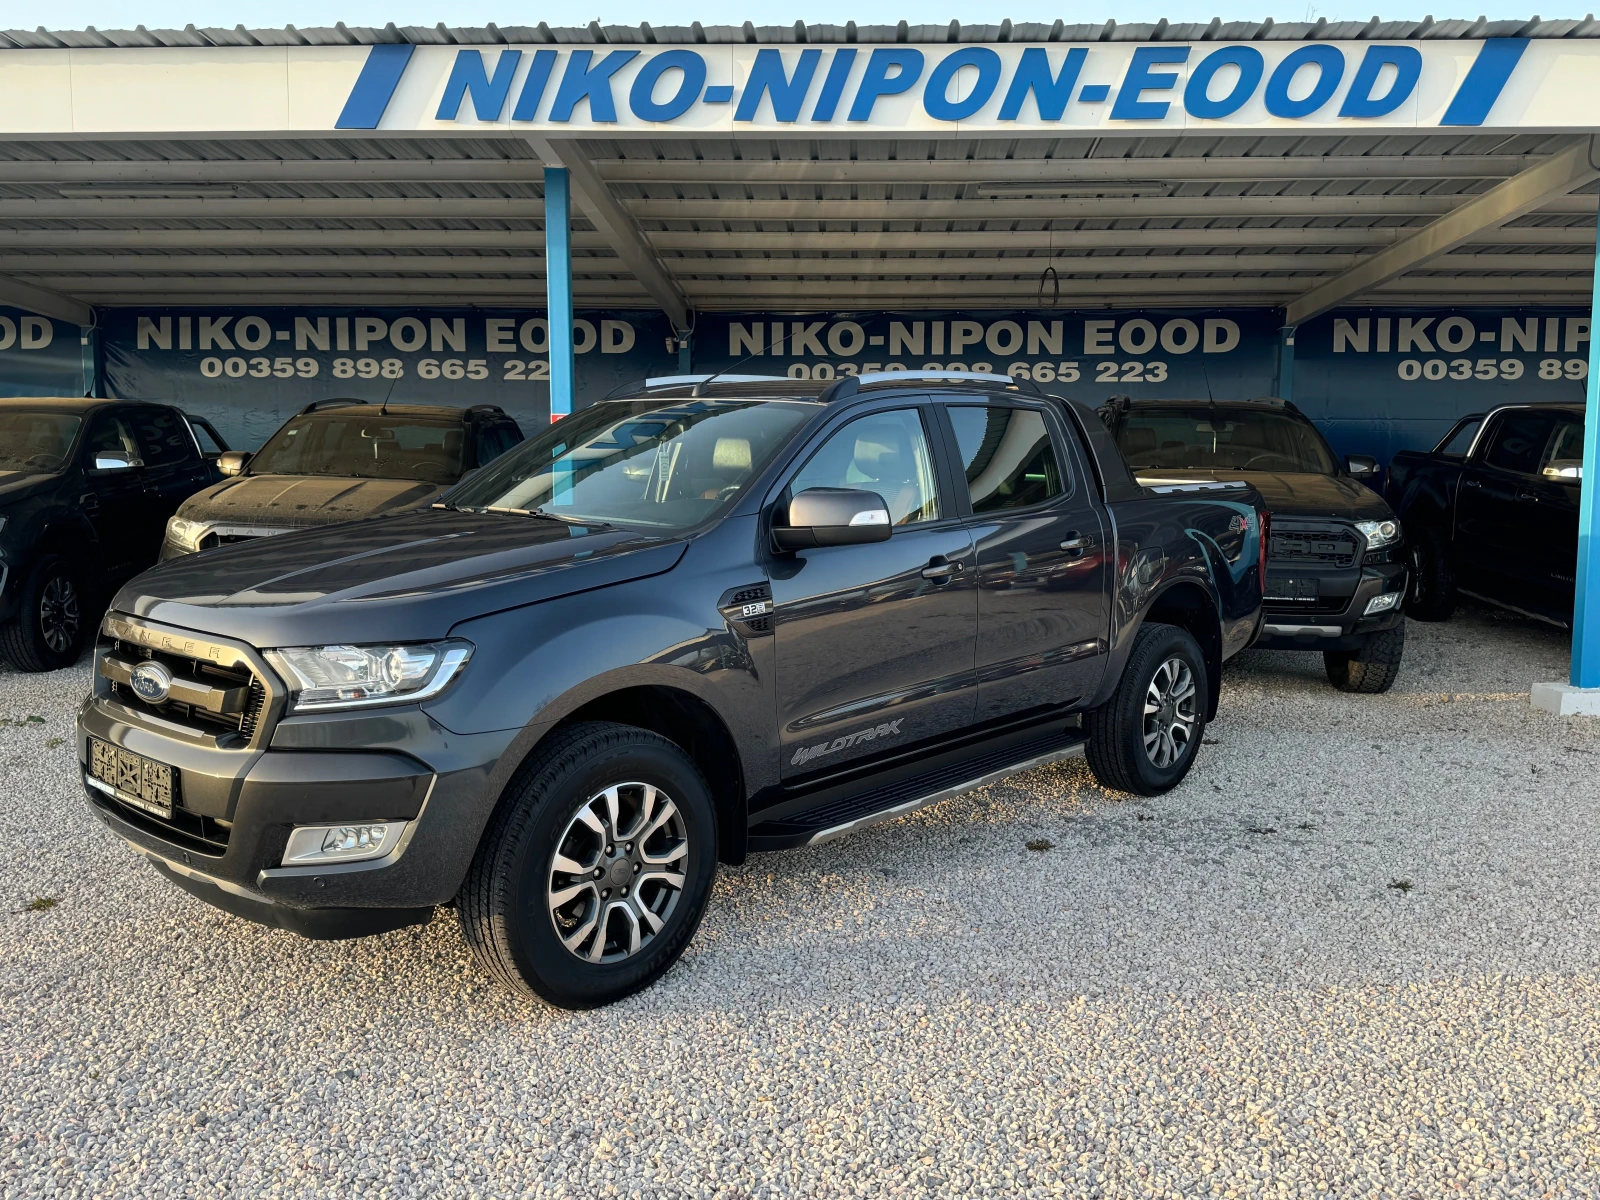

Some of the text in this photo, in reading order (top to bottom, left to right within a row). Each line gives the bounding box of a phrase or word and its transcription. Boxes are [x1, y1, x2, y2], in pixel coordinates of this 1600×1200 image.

[435, 43, 1422, 124] NIKO-NIPON-EOOD
[136, 315, 636, 355] NIKO-NIPON EOOD
[728, 318, 1241, 356] NIKO-NIPON EOOD
[1333, 316, 1592, 353] NIKO-NIP
[199, 355, 550, 381] 00359 898 665 22
[1007, 361, 1082, 383] 665
[1095, 361, 1169, 383] 223
[1397, 358, 1589, 381] 00359 89
[225, 528, 278, 537] RAN
[106, 618, 222, 659] RANGER
[790, 717, 905, 766] WILDTRAK
